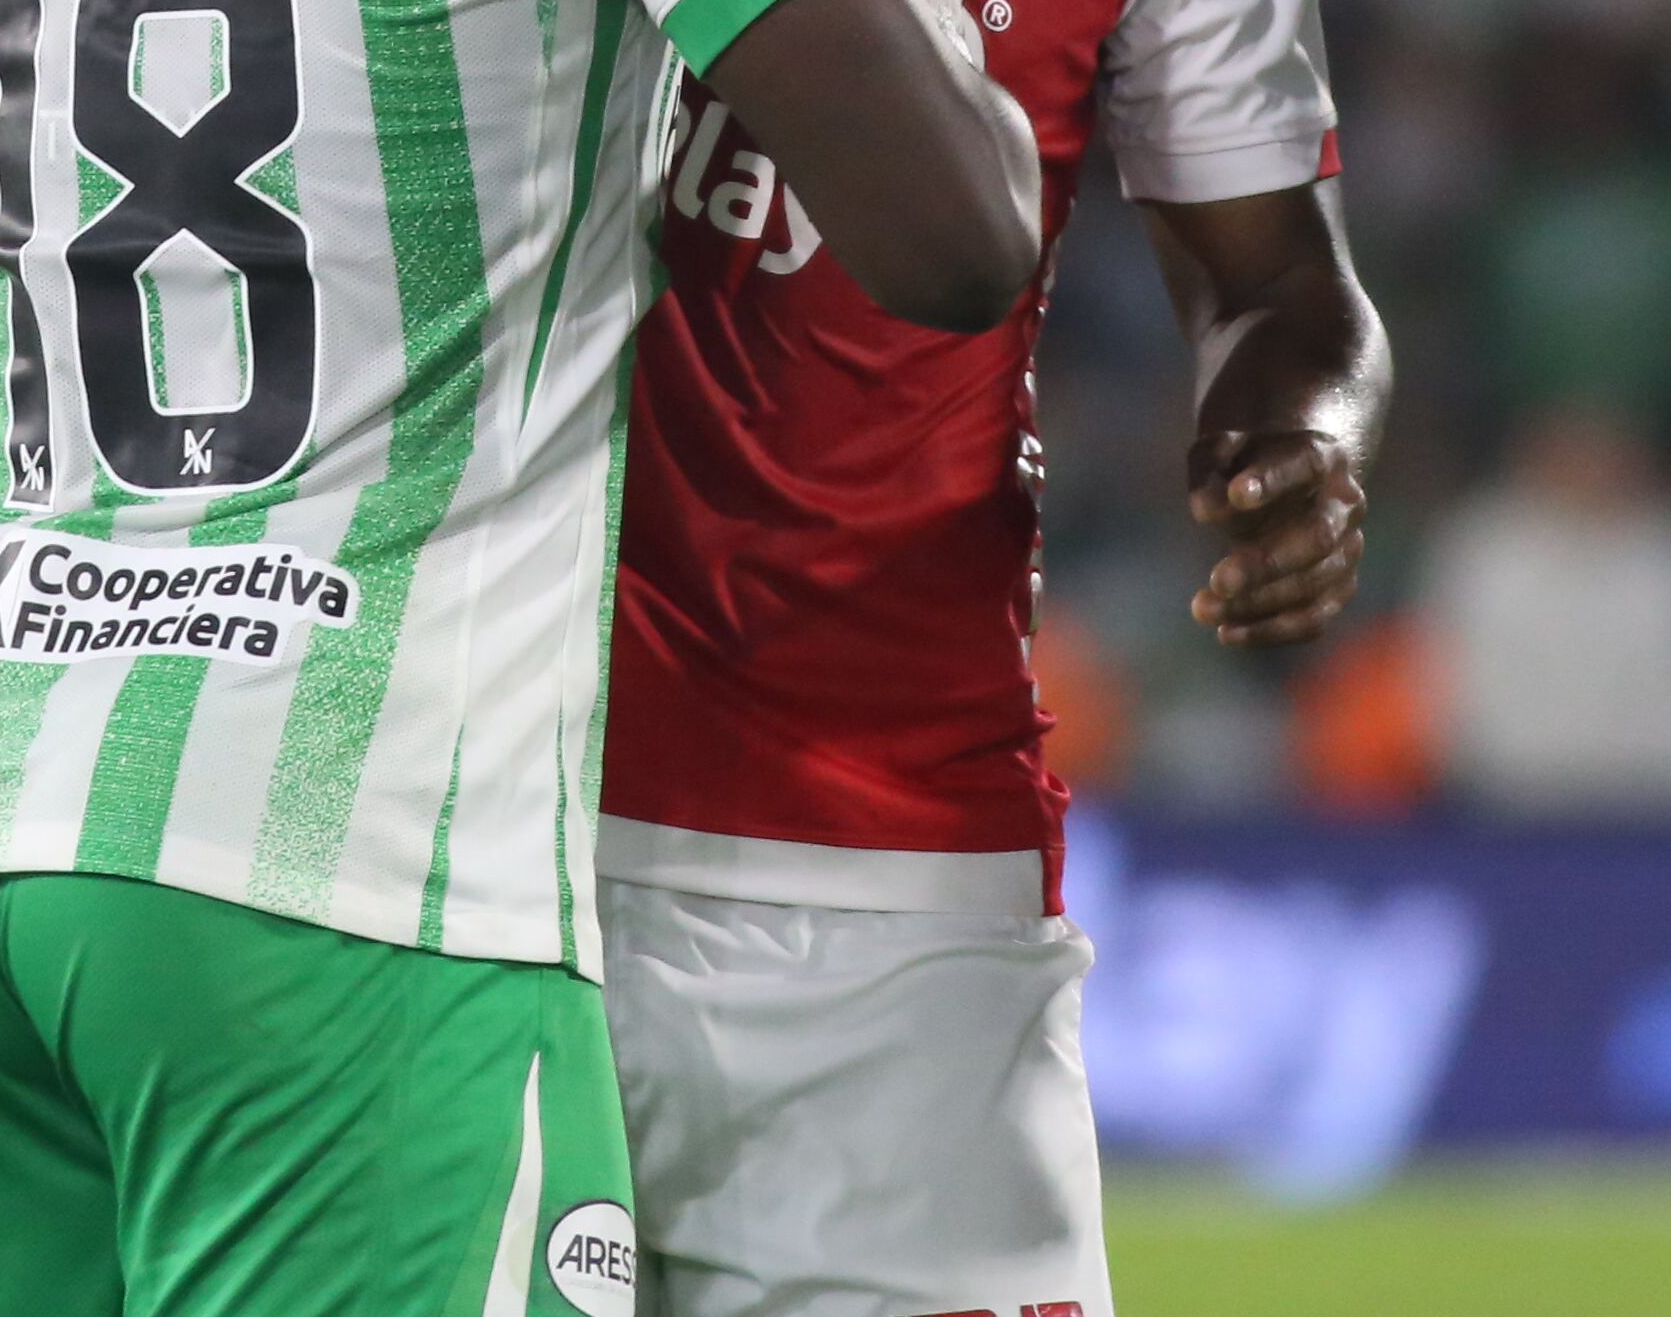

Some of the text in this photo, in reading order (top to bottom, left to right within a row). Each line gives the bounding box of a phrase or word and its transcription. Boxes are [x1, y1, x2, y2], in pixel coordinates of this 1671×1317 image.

[675, 99, 823, 275] lay
[28, 543, 350, 620] Cooperativa
[11, 601, 281, 658] Financiera
[556, 1234, 637, 1286] ARES
